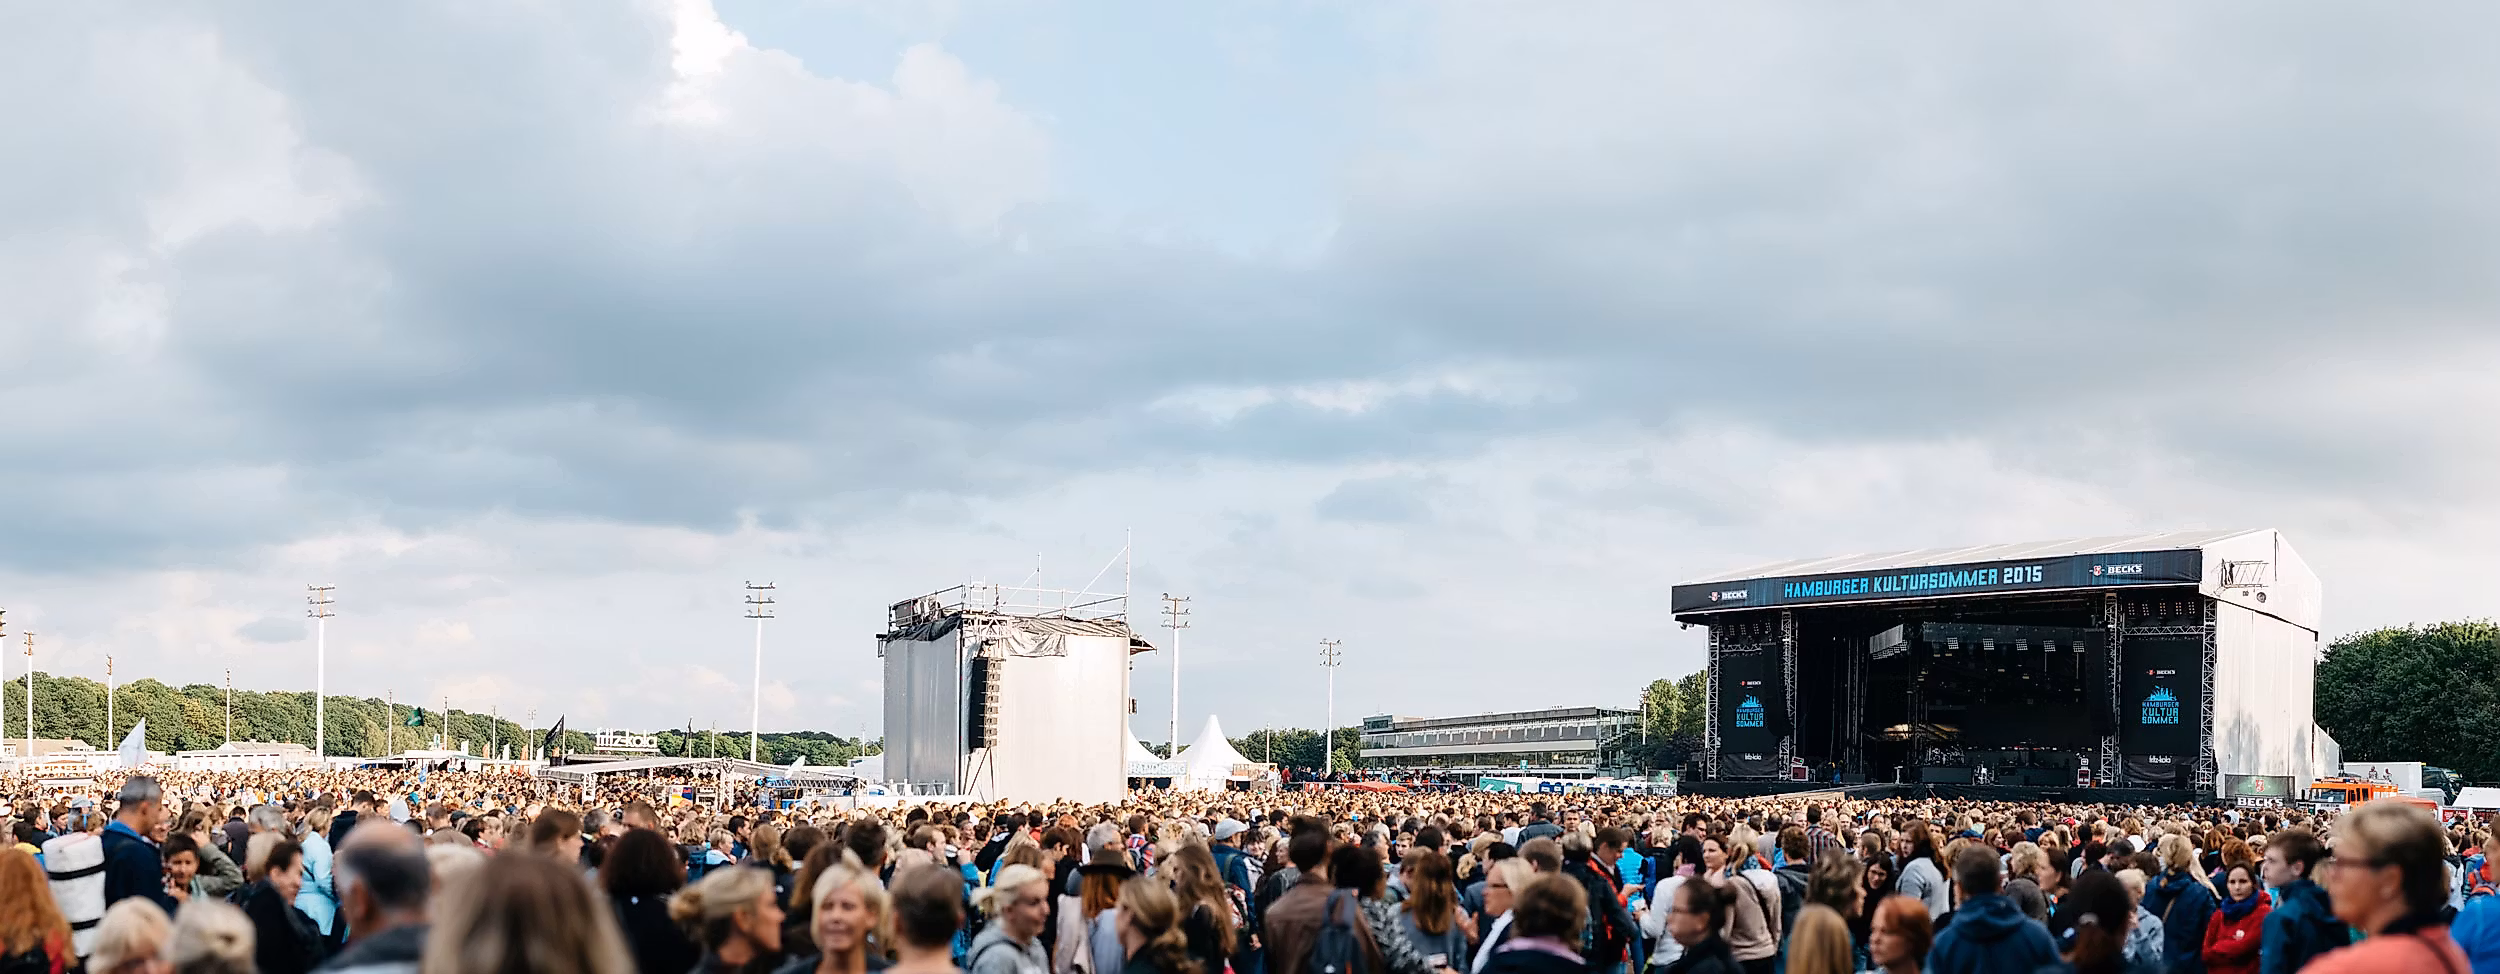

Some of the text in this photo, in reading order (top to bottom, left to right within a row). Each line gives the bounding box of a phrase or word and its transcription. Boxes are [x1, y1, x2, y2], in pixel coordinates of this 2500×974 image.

[2107, 564, 2143, 574] BECK'S
[1784, 566, 2043, 598] HAMBURGER KULTURSOMMER 2015
[2142, 708, 2179, 716] KULTUR
[1736, 720, 1764, 728] SOMMER
[2142, 716, 2179, 724] SOMMER
[1129, 763, 1187, 774] HANDISING
[2237, 797, 2283, 807] BECK'S
